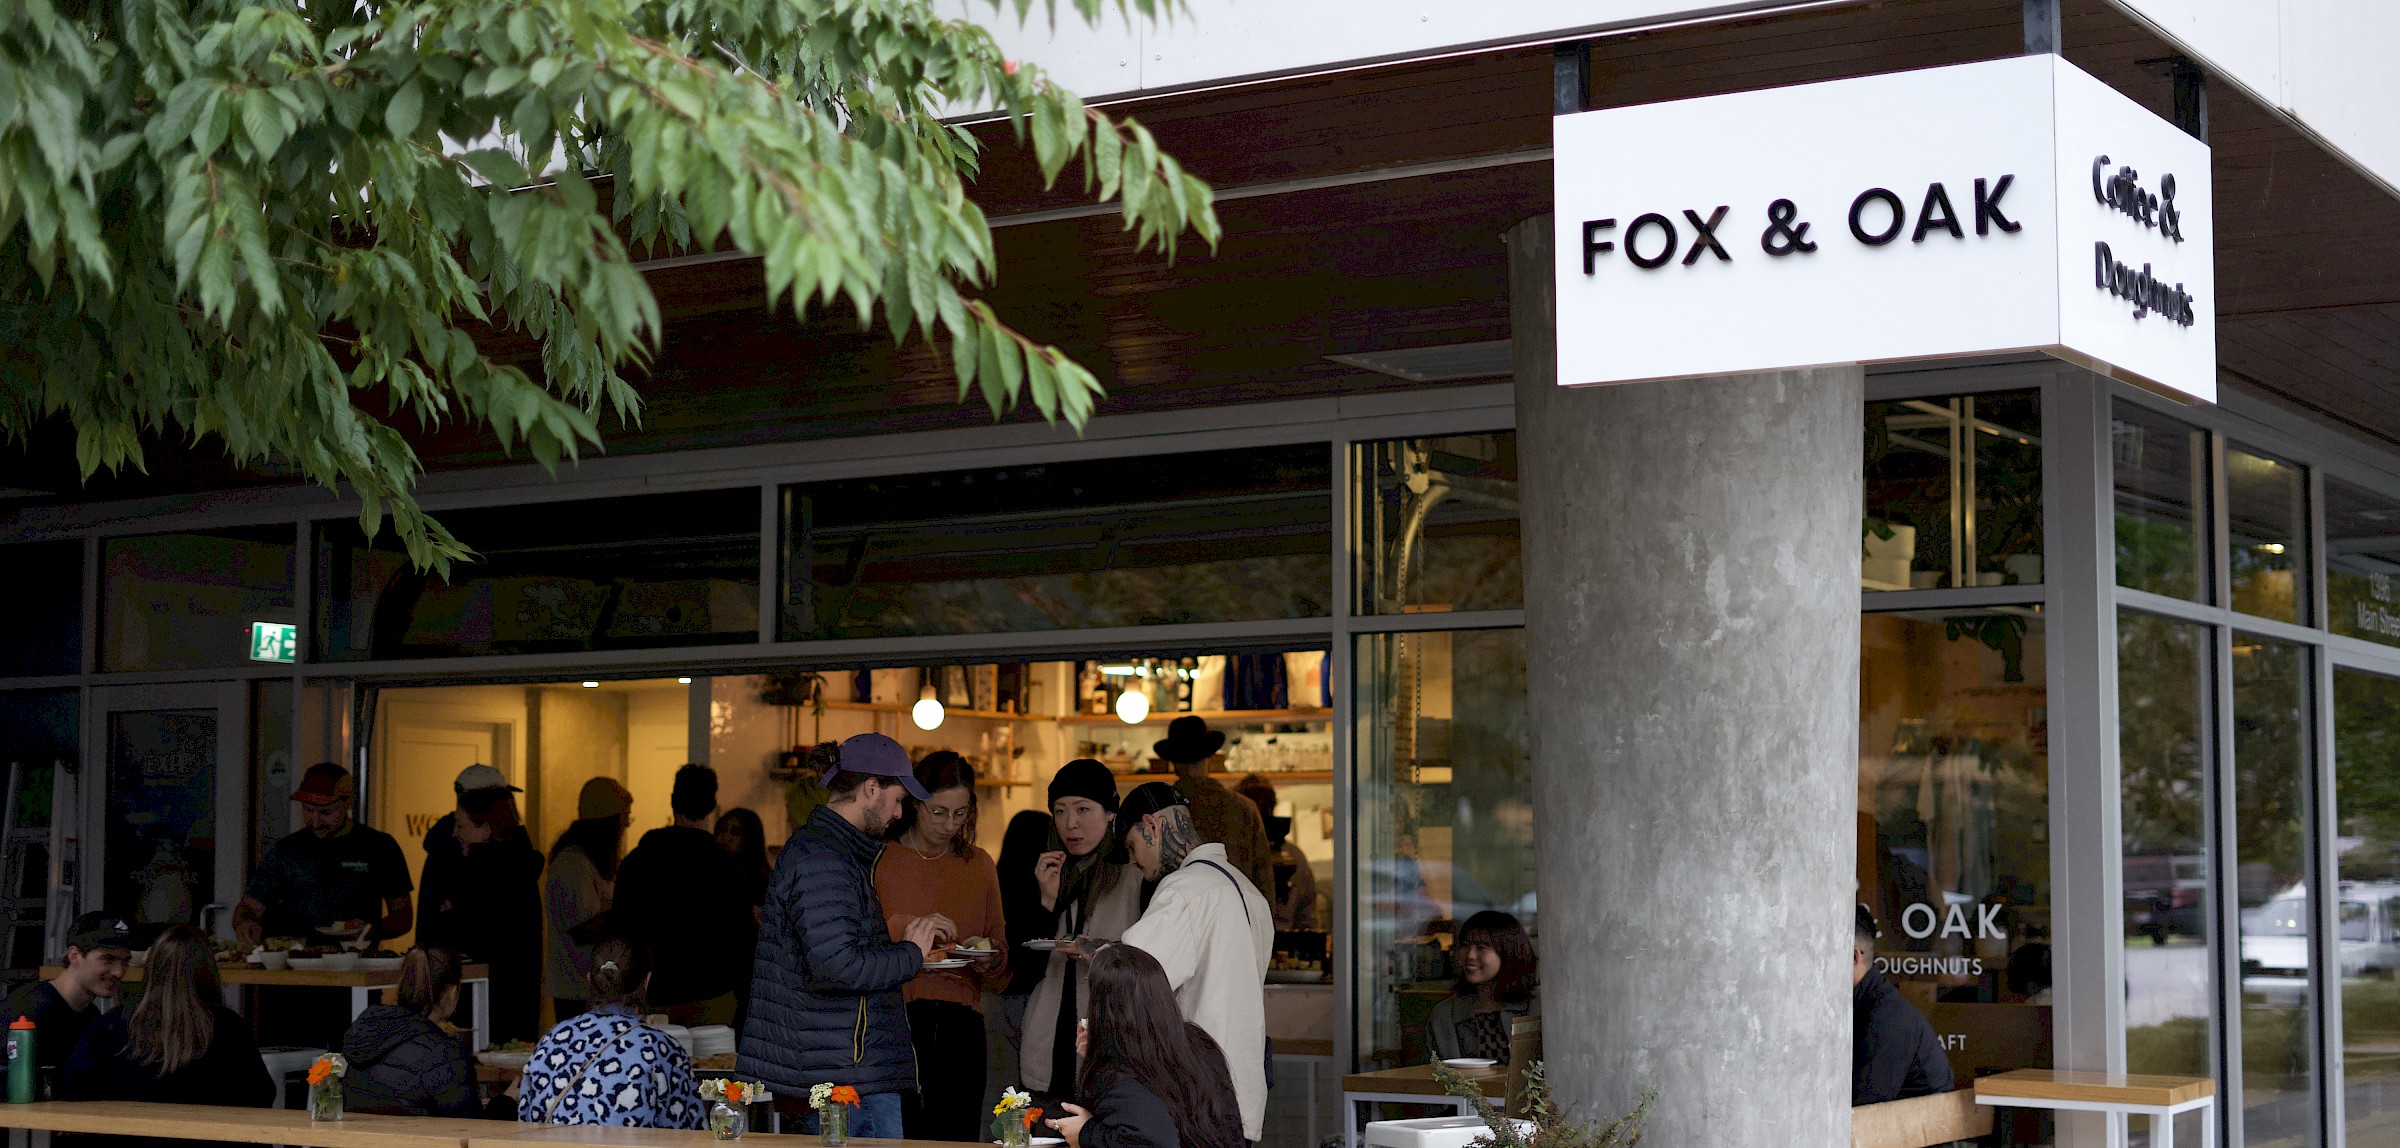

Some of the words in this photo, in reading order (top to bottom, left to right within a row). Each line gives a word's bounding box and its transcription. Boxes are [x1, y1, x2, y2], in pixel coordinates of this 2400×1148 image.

[2092, 154, 2159, 229] Coffee
[2158, 172, 2185, 243] &
[1582, 205, 1733, 276] FOX
[1761, 198, 1818, 257] &
[1848, 173, 2022, 247] OAK
[2095, 241, 2194, 327] Doughnuts
[2357, 601, 2377, 631] Main
[1901, 902, 2007, 940] OAK
[1874, 957, 1983, 975] OUGHNUTS
[1937, 1034, 1967, 1051] AFT
